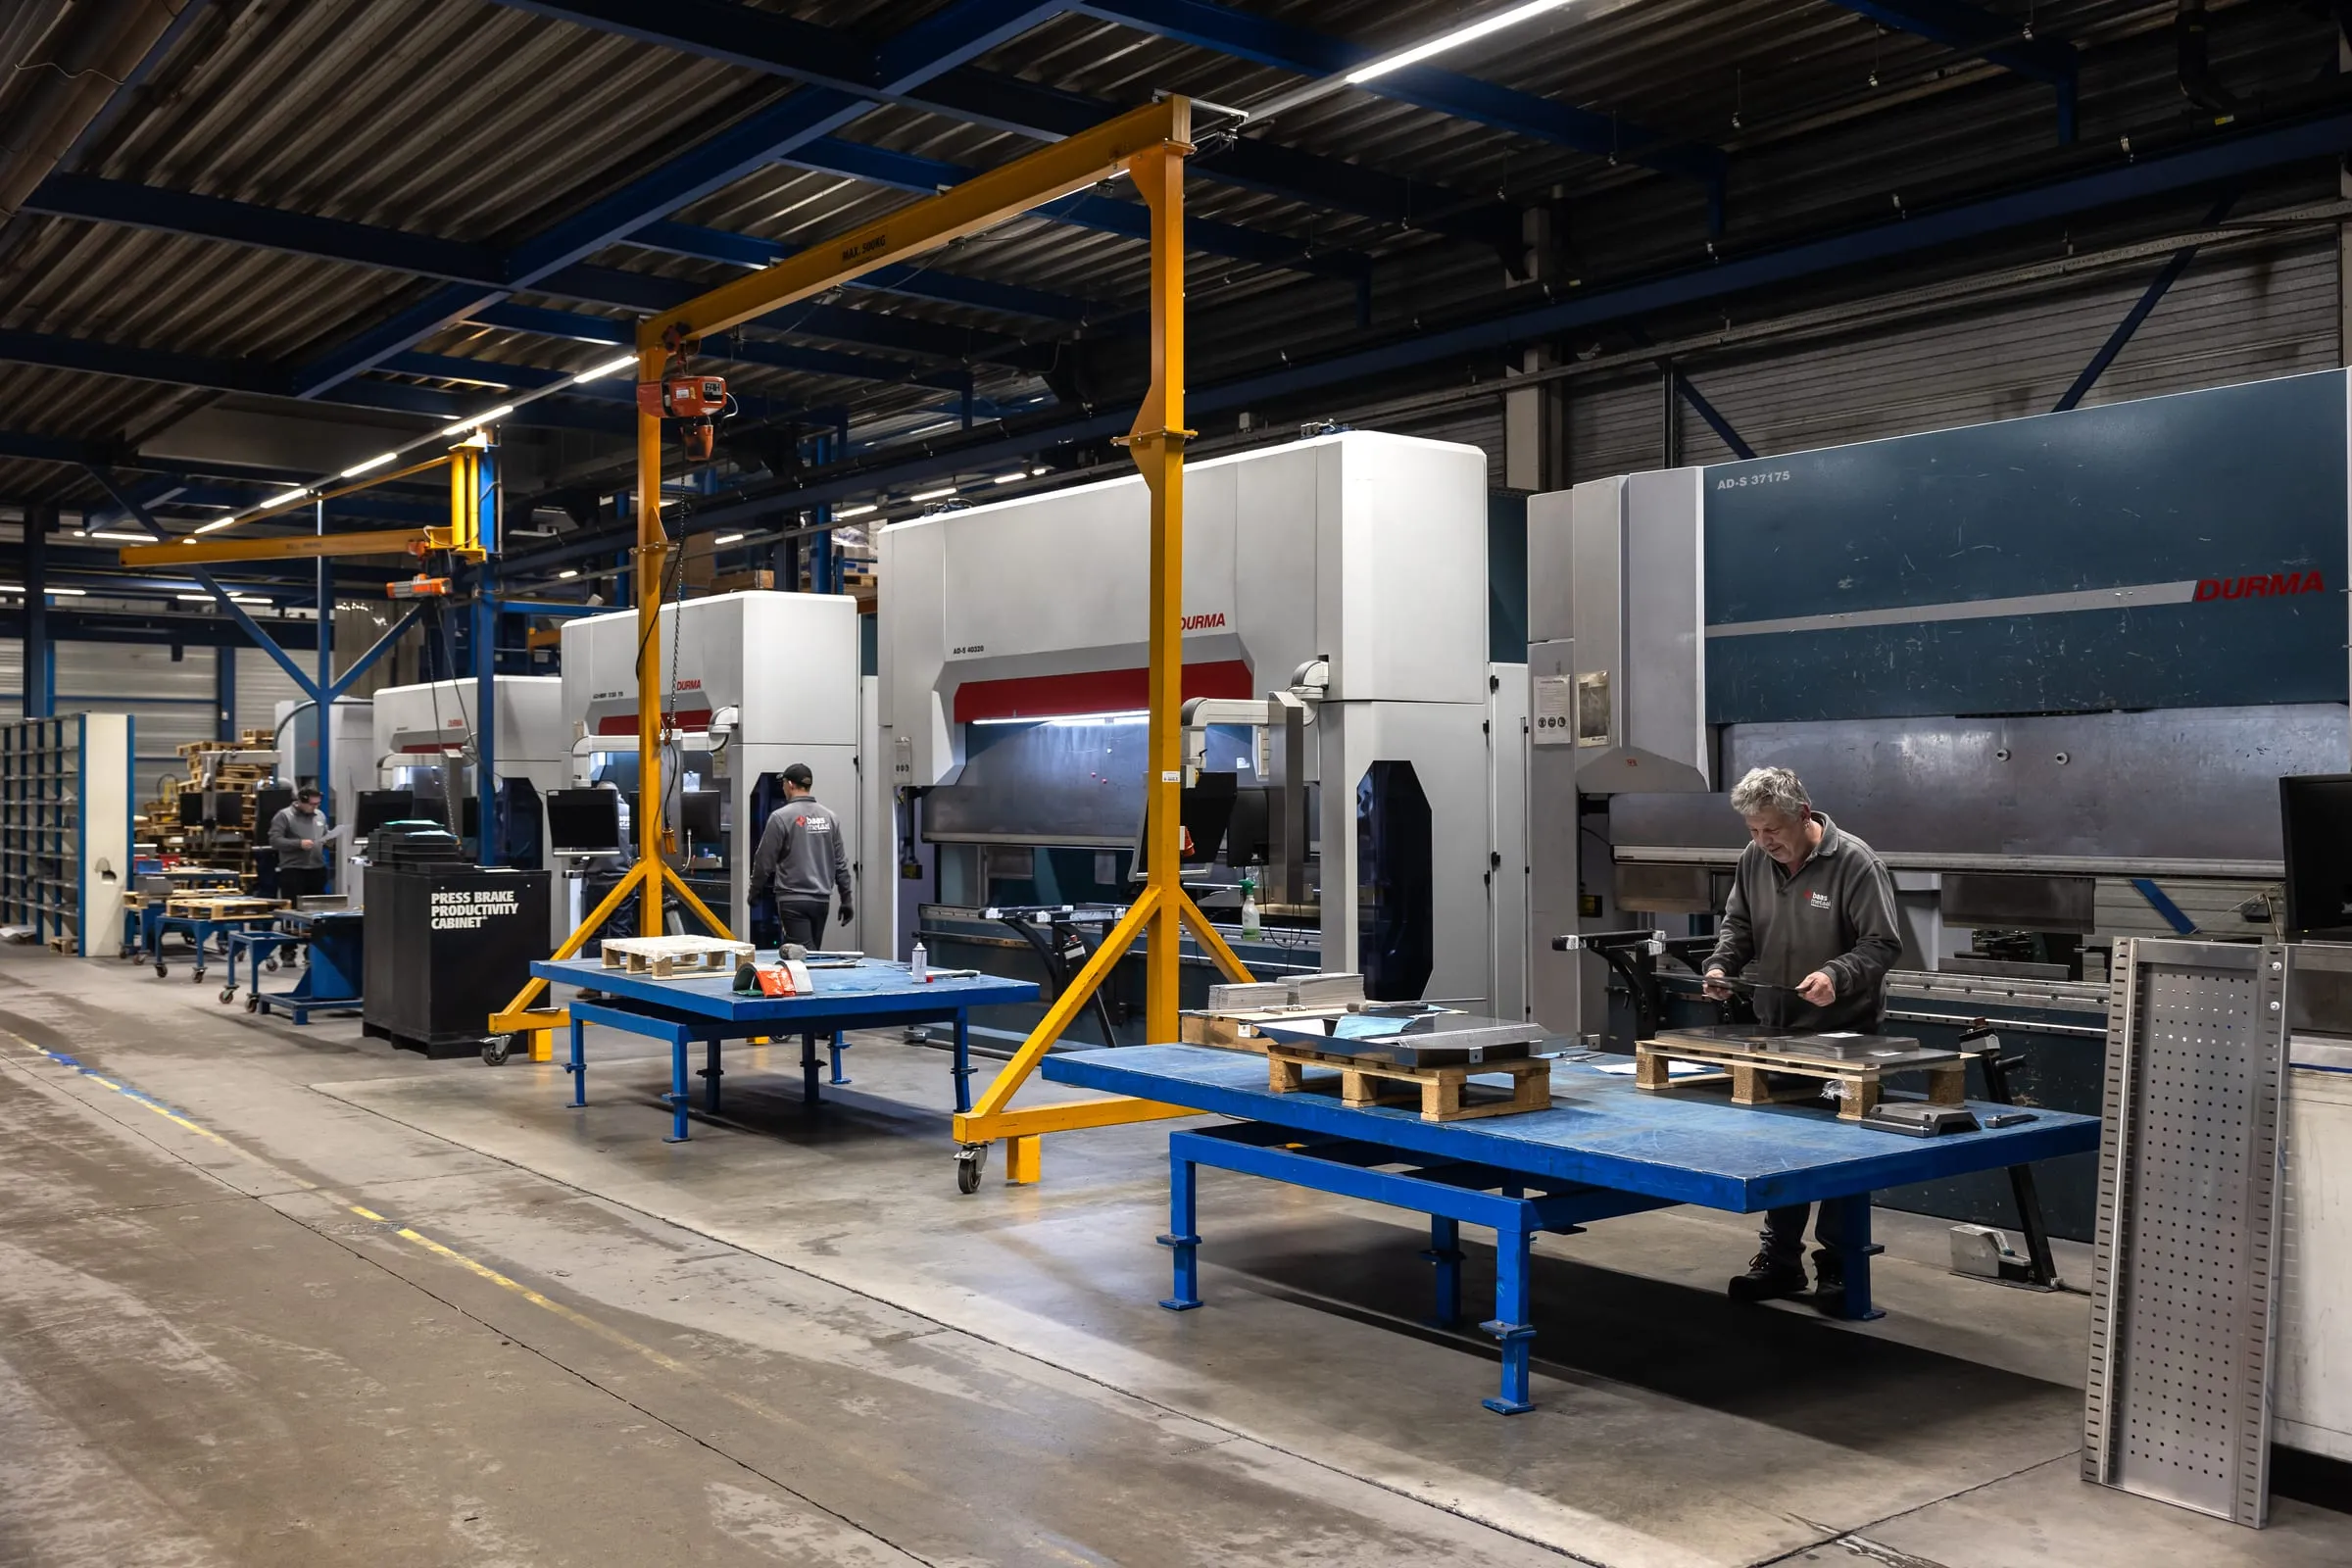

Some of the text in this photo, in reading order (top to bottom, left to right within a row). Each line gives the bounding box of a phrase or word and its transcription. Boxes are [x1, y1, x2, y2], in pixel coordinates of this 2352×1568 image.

[1717, 470, 1790, 490] AD-S 37175
[2195, 570, 2326, 602] DURMA
[676, 679, 702, 691] DURMA
[807, 816, 825, 825] baas
[431, 890, 514, 905] PRESS BRAKE
[1812, 891, 1828, 902] baas
[431, 903, 519, 917] PRODUCTIVITY
